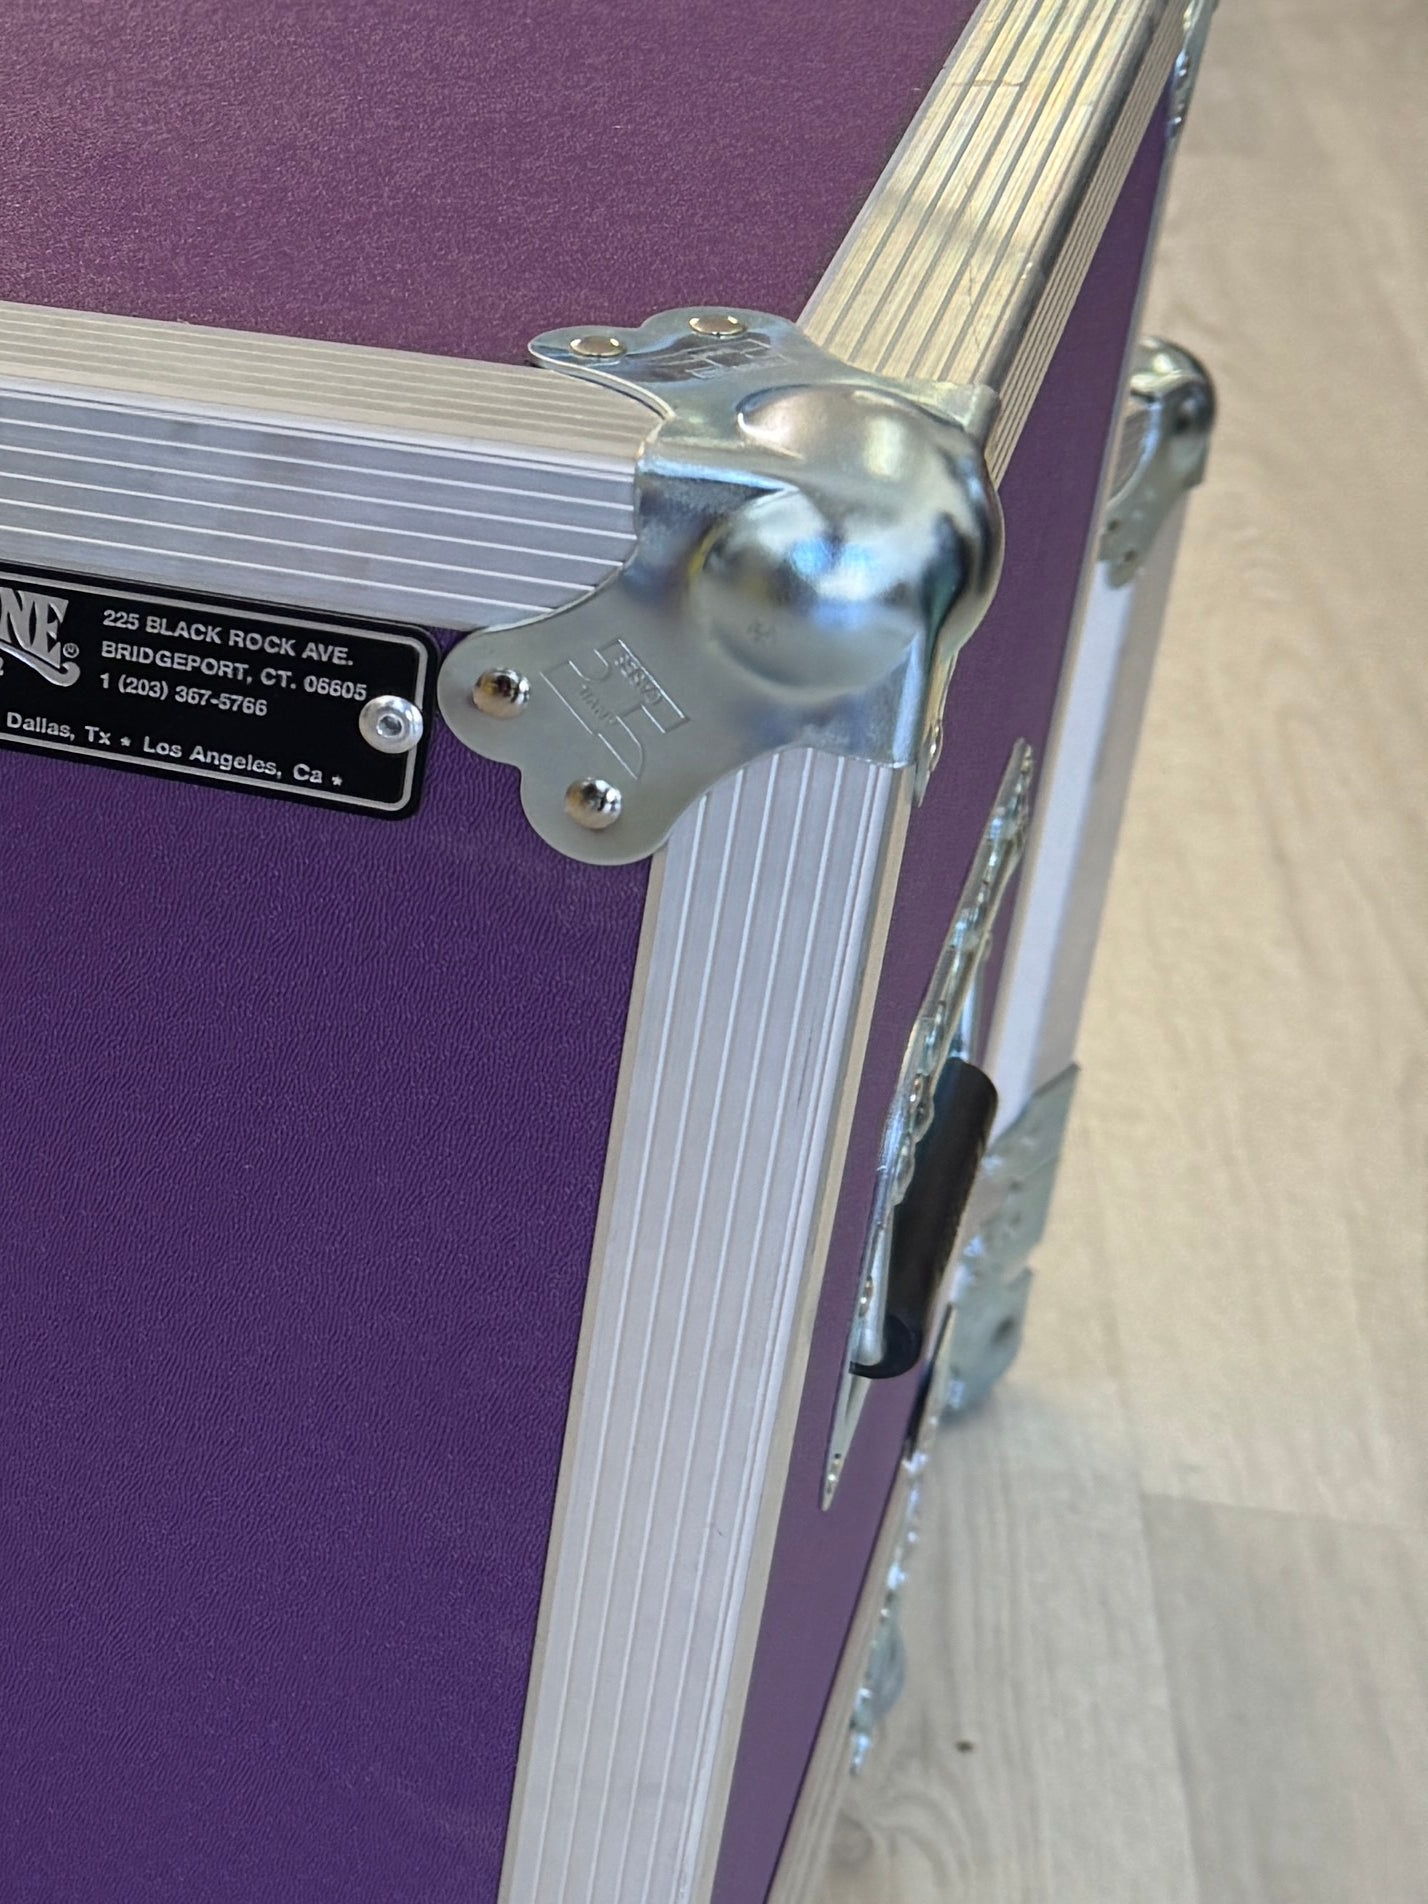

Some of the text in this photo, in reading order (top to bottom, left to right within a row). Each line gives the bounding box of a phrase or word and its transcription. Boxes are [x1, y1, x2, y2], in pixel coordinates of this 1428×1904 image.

[102, 609, 354, 666] 225 BLACK ROCK AVE.
[100, 672, 268, 717] 1 (203) 367-5766
[101, 641, 368, 701] BRIDGEPORT, CT. 06605
[6, 712, 75, 741] Dallas,
[84, 725, 111, 746] Tx
[143, 736, 183, 758] Los
[189, 745, 282, 779] Angeles,
[293, 763, 323, 784] Ca
